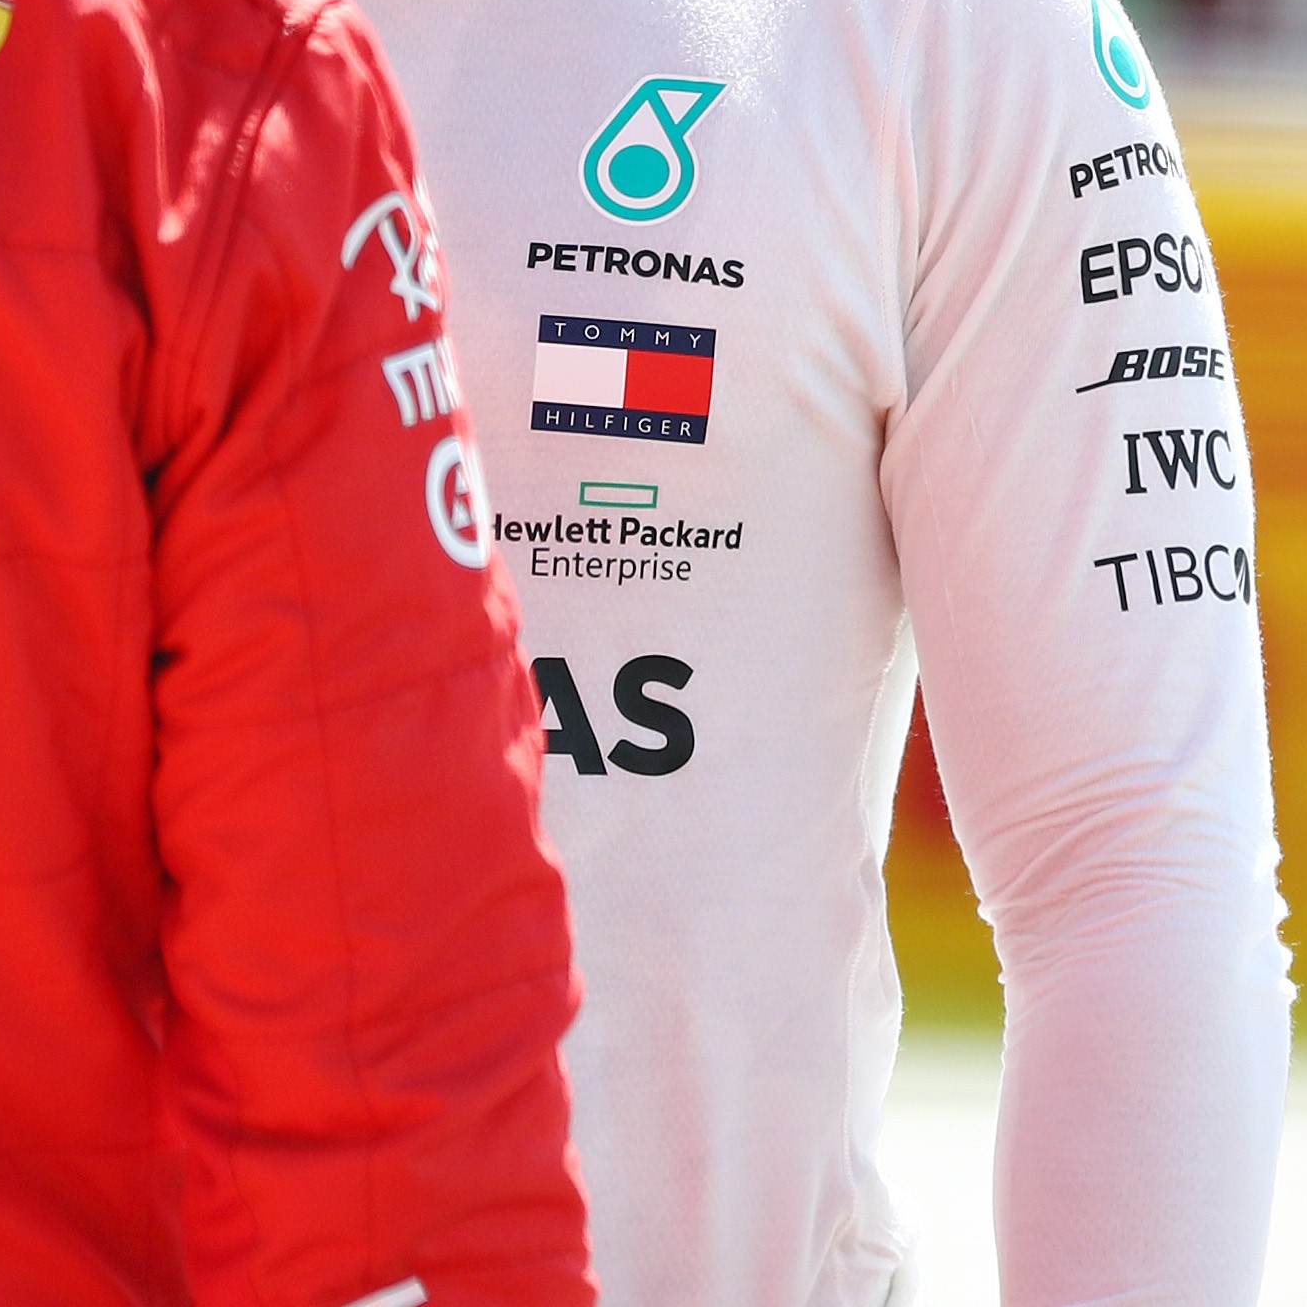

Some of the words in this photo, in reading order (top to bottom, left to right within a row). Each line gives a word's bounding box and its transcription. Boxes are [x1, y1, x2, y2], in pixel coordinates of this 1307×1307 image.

[527, 242, 745, 288] PETRONAS
[554, 322, 702, 350] TOMMY
[1076, 346, 1225, 393] BOSE
[546, 410, 691, 437] HILFIGER
[1123, 428, 1236, 494] IWC
[619, 517, 743, 549] Packard
[531, 547, 692, 585] Enterprise
